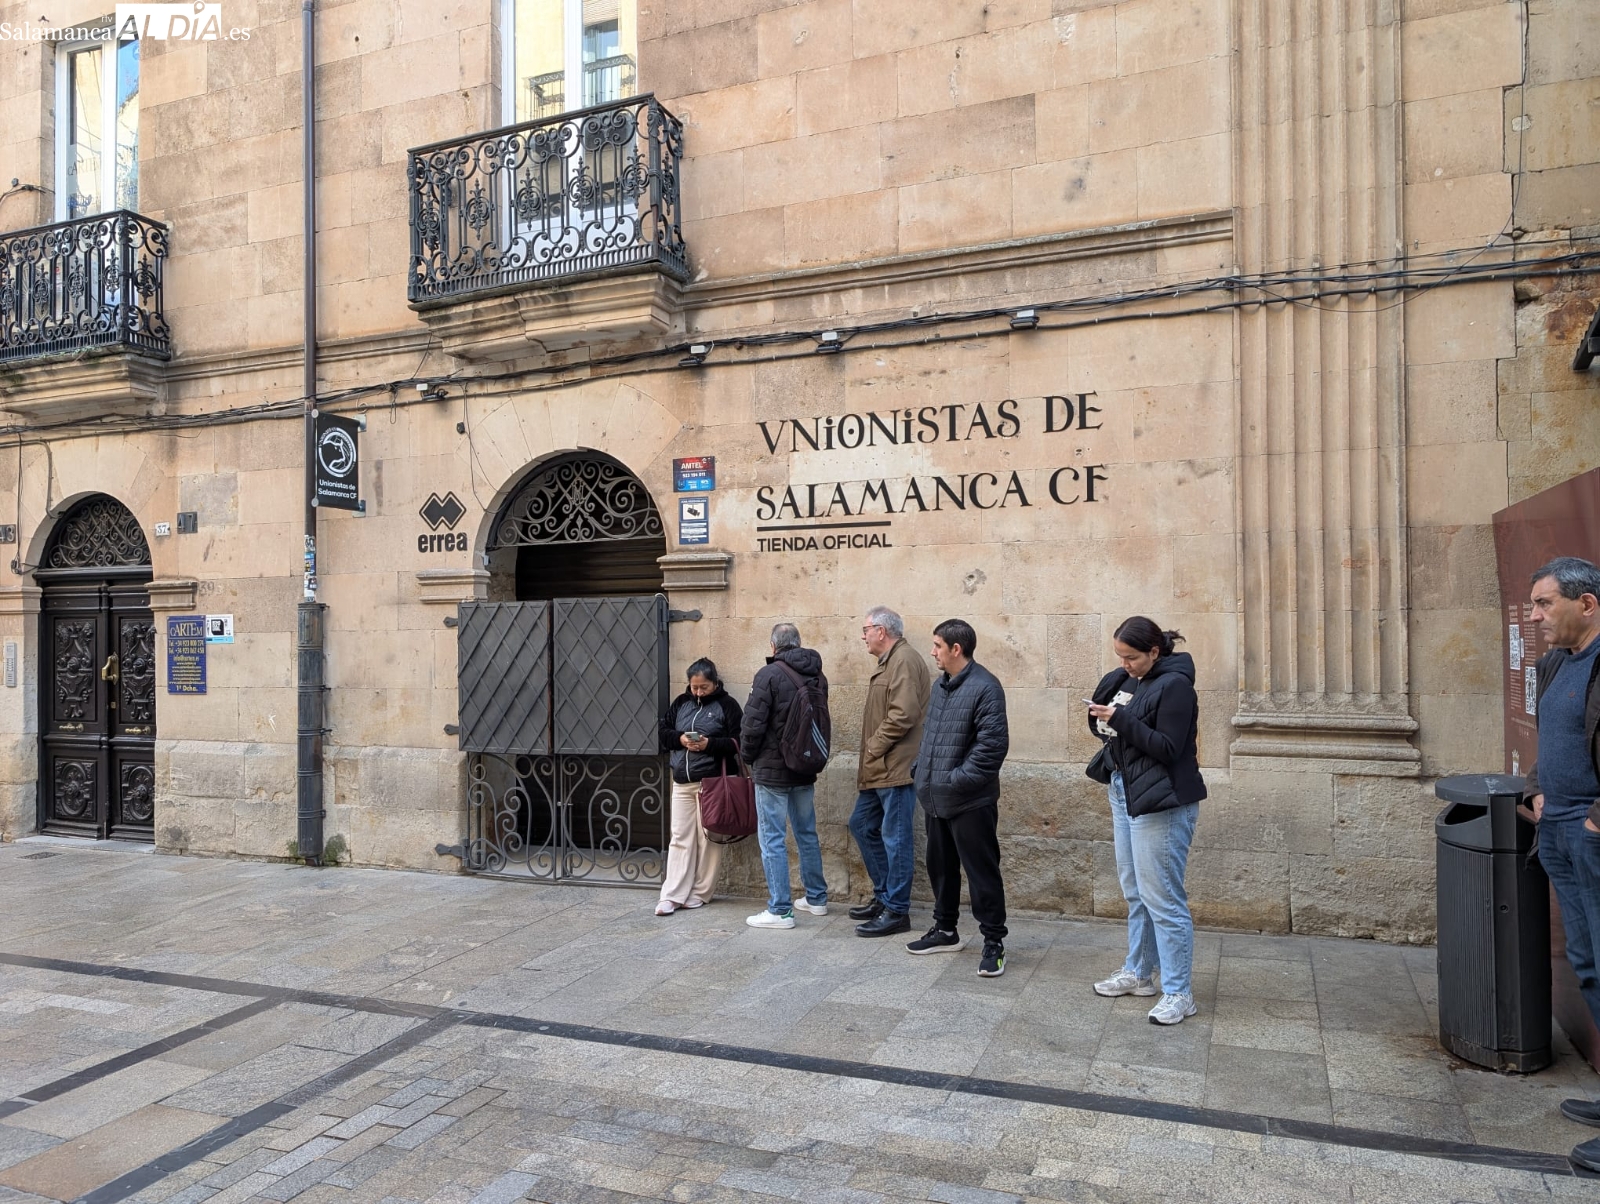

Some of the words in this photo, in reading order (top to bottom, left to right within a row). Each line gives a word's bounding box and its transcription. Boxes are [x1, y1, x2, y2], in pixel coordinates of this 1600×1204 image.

[1042, 390, 1104, 434] DE
[681, 462, 704, 470] AMTEL
[319, 479, 348, 490] Unionistas
[318, 488, 349, 498] Salamanca
[756, 470, 1033, 521] SALAMANCA
[1049, 464, 1109, 505] CF
[757, 536, 819, 553] TIENDA
[822, 533, 893, 550] OFICIAL
